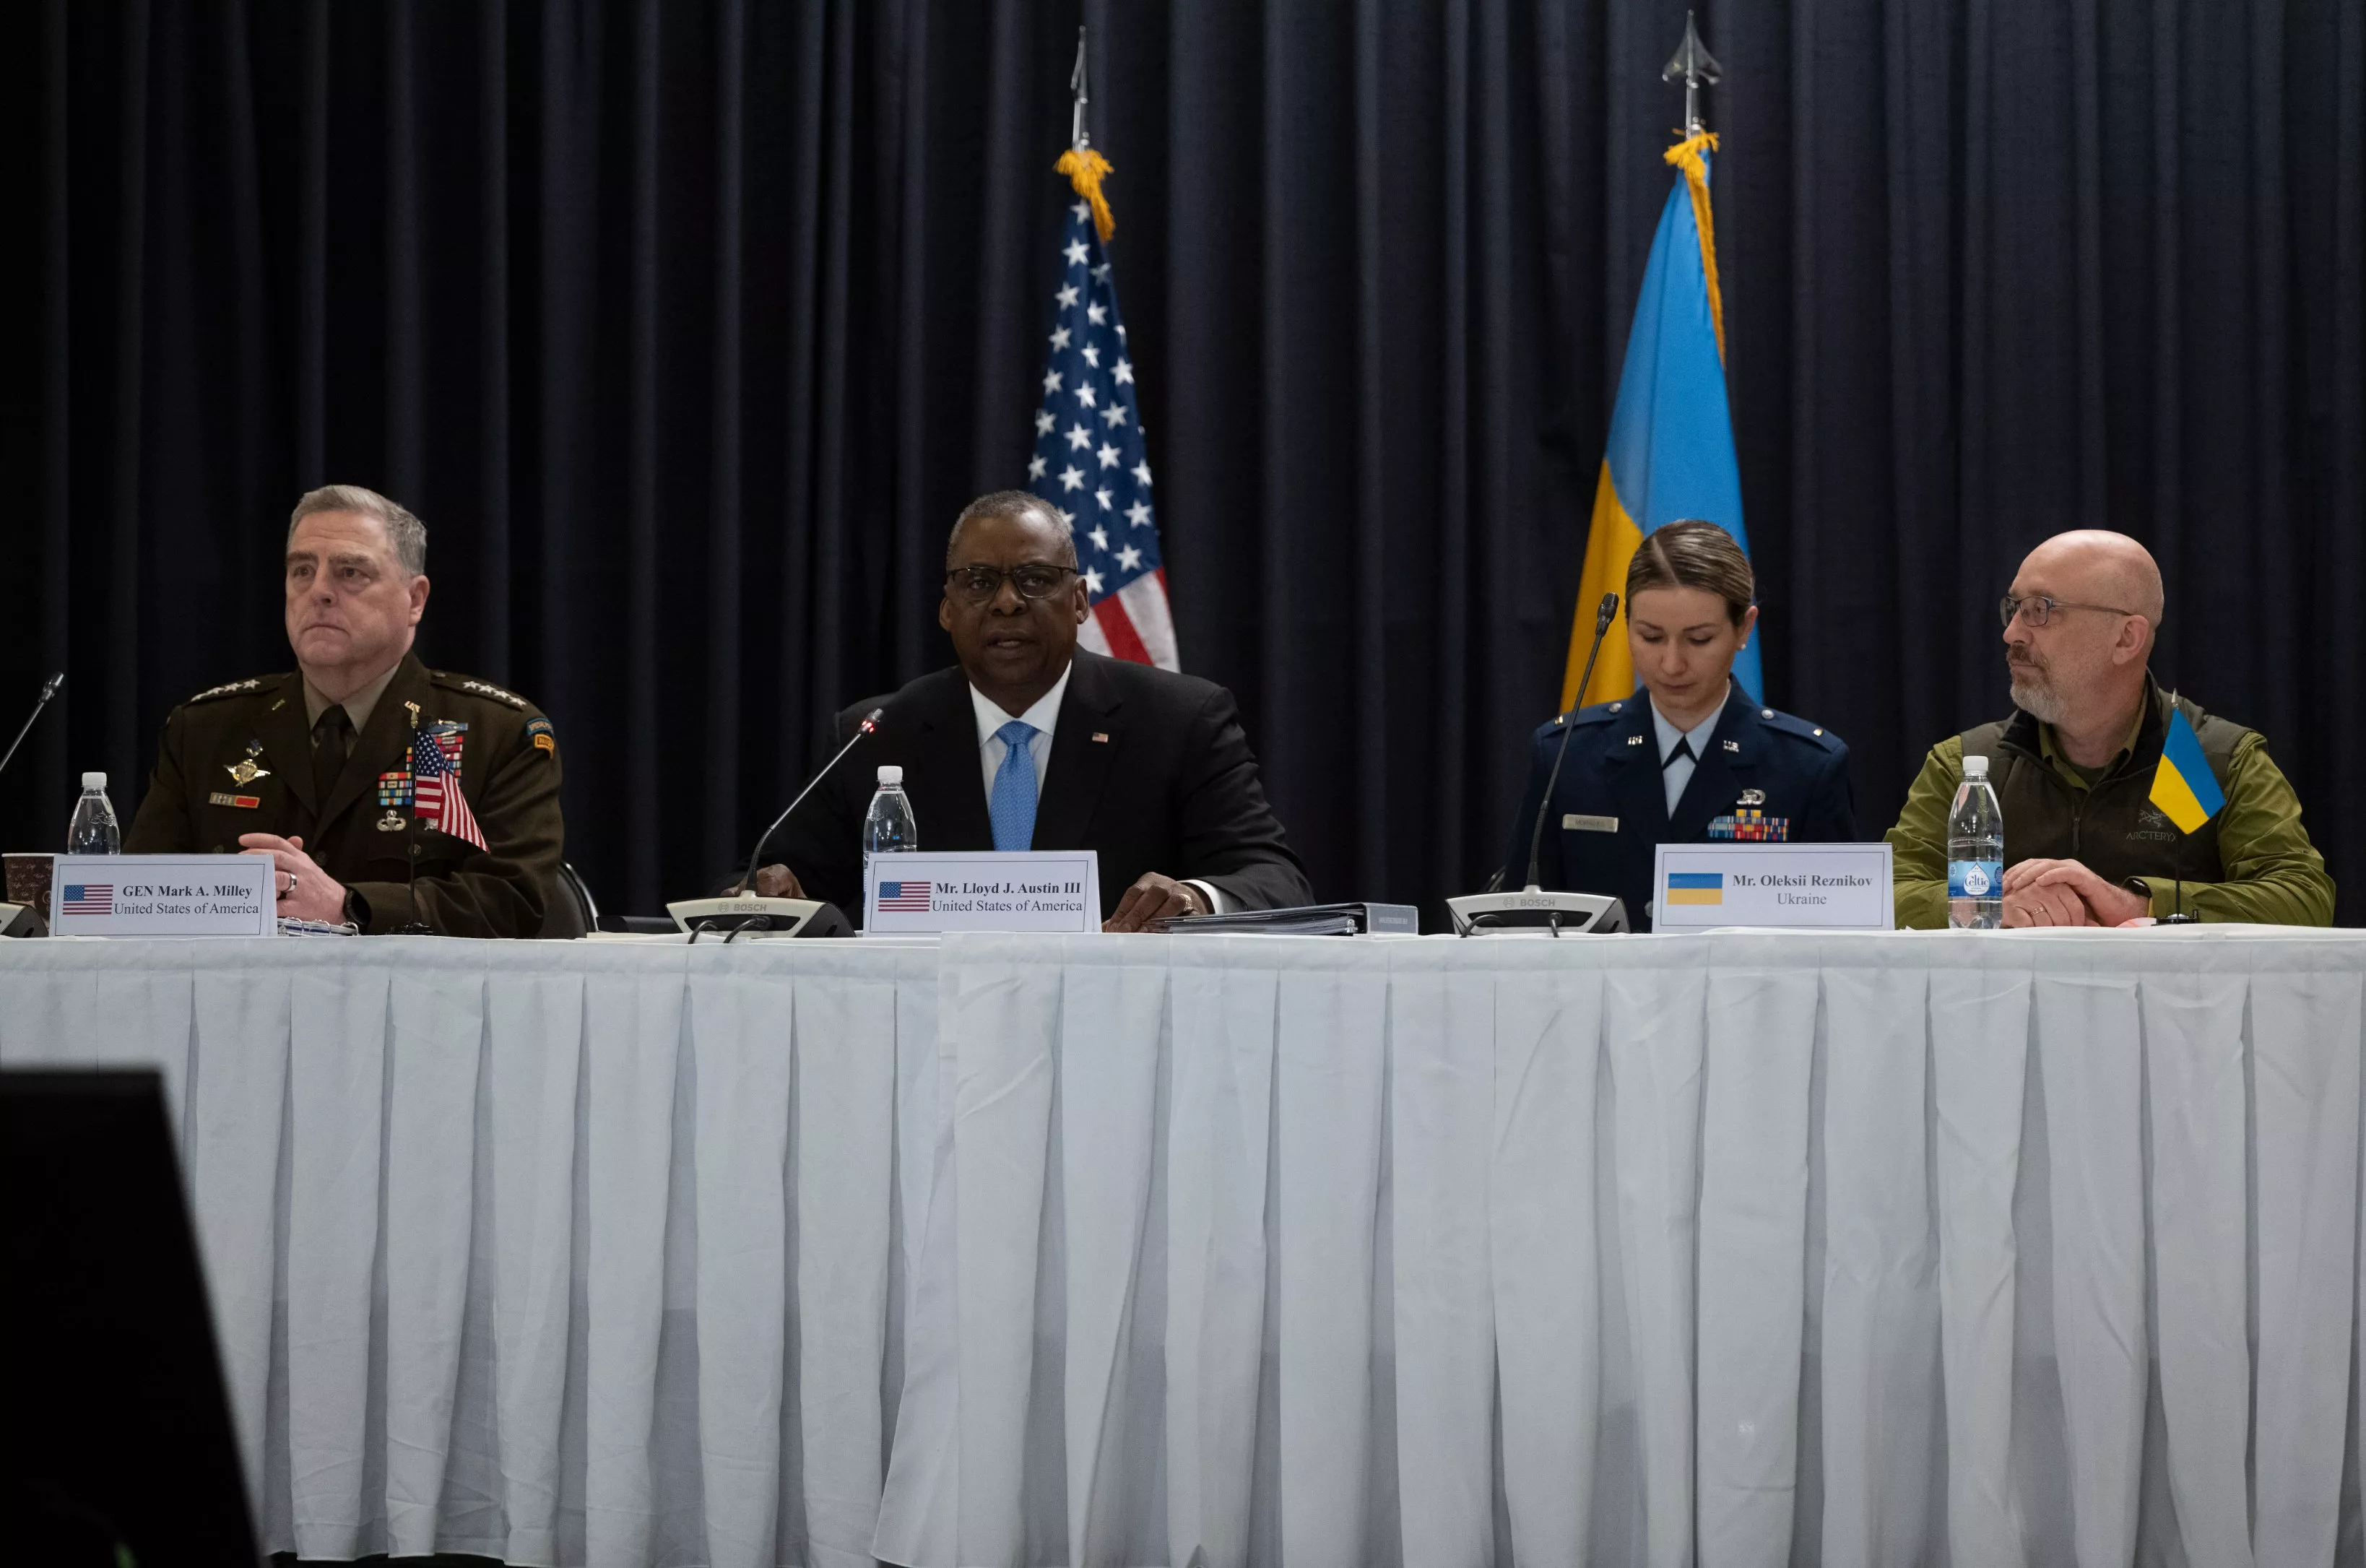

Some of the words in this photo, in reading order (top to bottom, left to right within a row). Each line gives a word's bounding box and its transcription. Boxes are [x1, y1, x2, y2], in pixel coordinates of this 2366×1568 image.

[1733, 875, 1756, 886] Mr.
[1760, 875, 1806, 886] Oleksii
[1811, 875, 1873, 886] Reznikov
[1964, 874, 1989, 887] Celtic
[123, 885, 153, 896] GEN
[157, 885, 193, 896] Mark
[196, 885, 209, 896] A.
[213, 885, 252, 899] Milley
[935, 883, 958, 894] Mr.
[963, 883, 1000, 896] Lloyd
[1002, 883, 1014, 894] J.
[1017, 882, 1060, 893] Austin
[1064, 882, 1081, 893] III
[932, 900, 972, 911] United
[976, 900, 1012, 911] States
[1015, 899, 1031, 911] of
[1031, 900, 1083, 911] America
[1777, 893, 1827, 905] Ukraine
[114, 903, 153, 914] United
[157, 903, 191, 914] States
[194, 903, 209, 914] of
[209, 903, 259, 914] America
